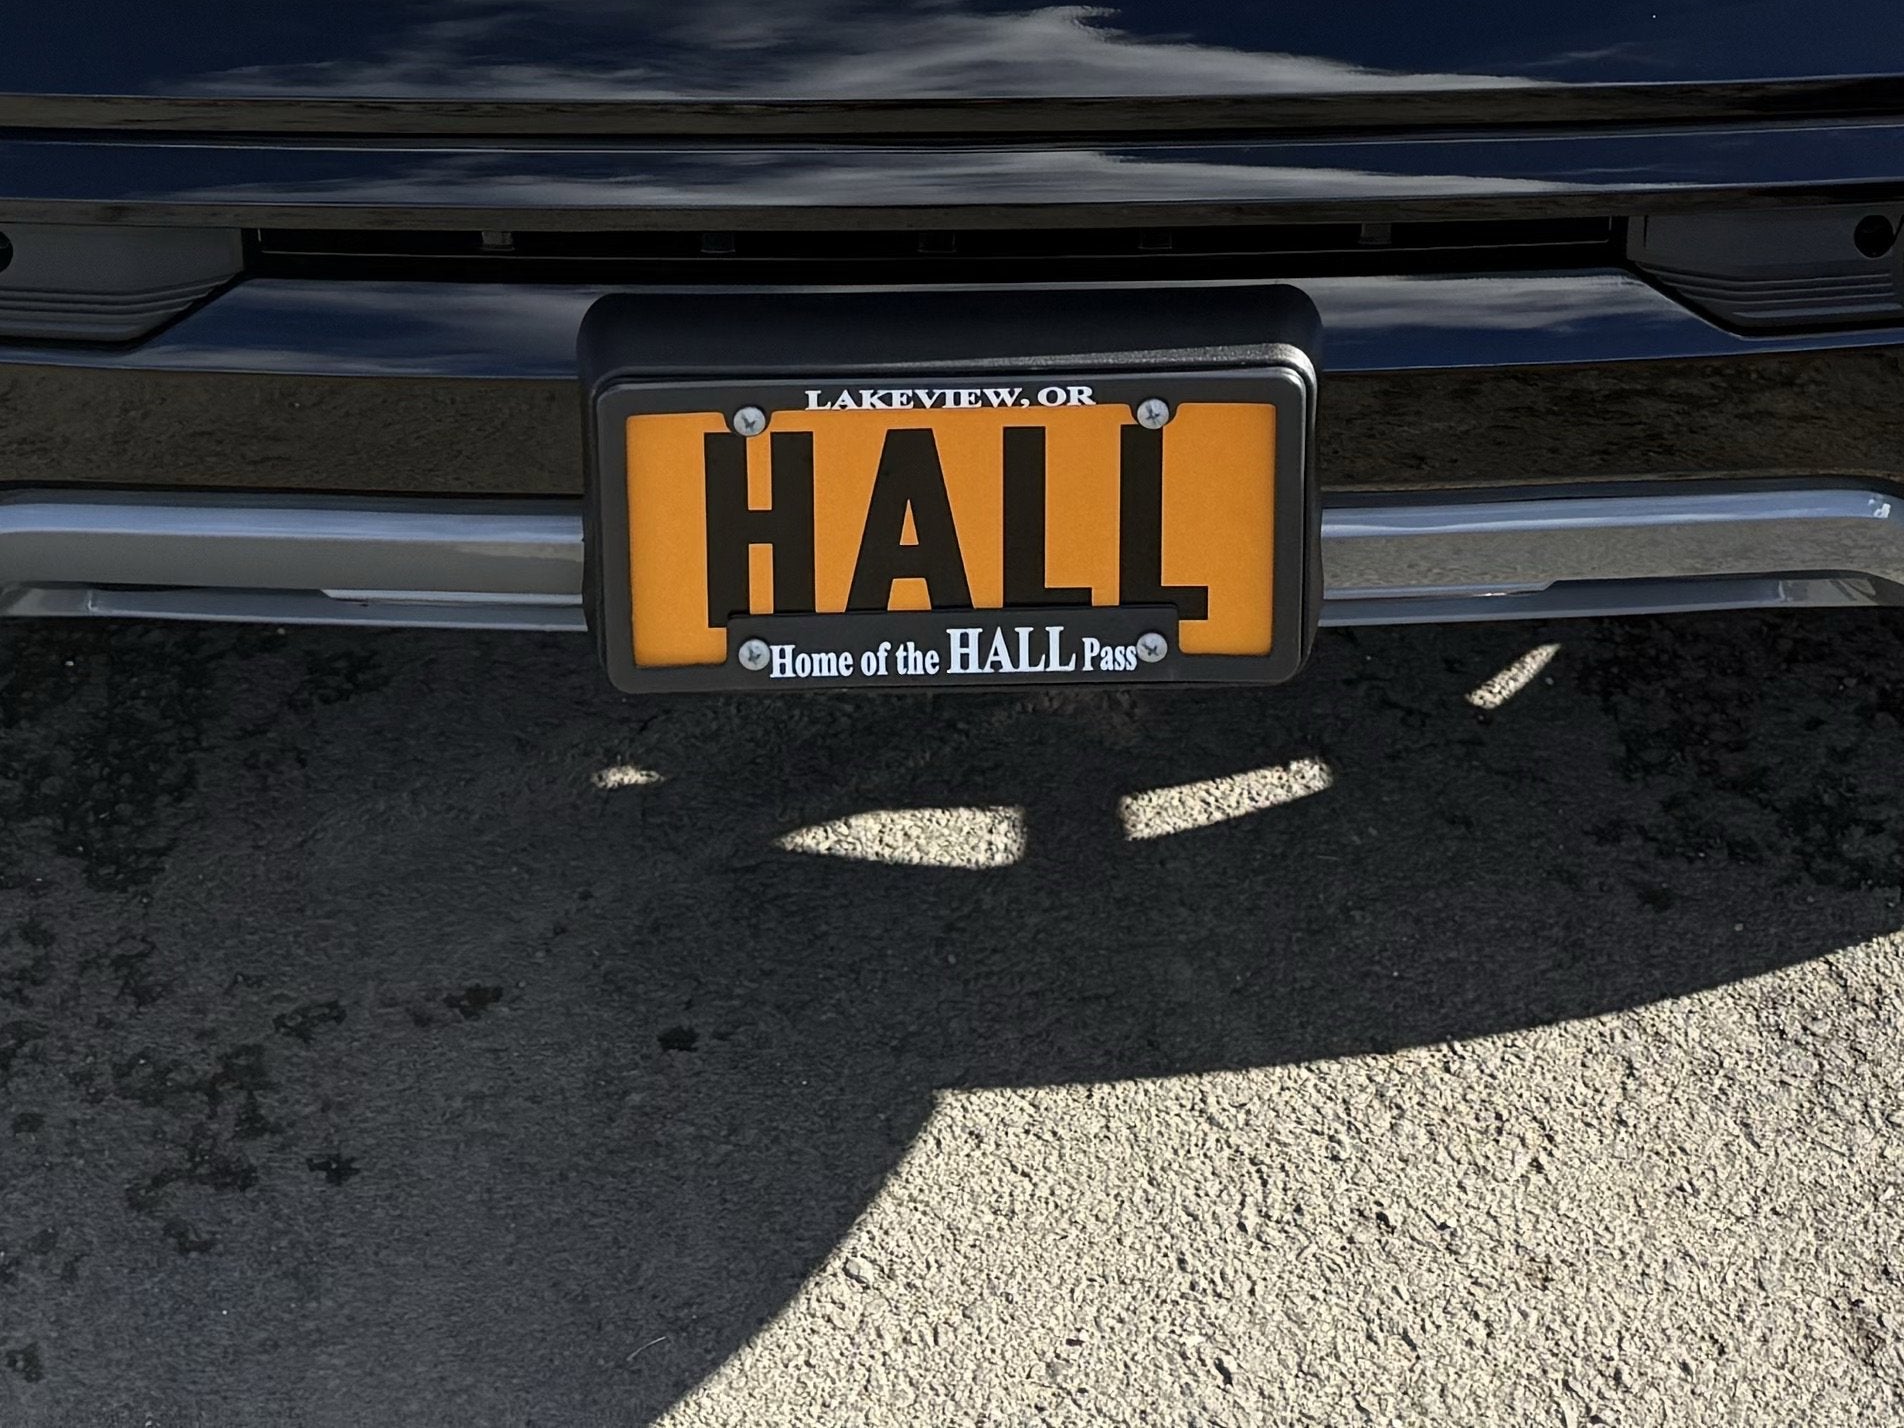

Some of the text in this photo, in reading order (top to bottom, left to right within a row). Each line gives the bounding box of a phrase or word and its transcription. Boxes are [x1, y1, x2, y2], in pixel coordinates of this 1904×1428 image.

[805, 386, 1096, 410] LAKEVIEW, OR
[704, 423, 1209, 628] HALL
[769, 626, 1138, 678] Home of the HALL Pass
